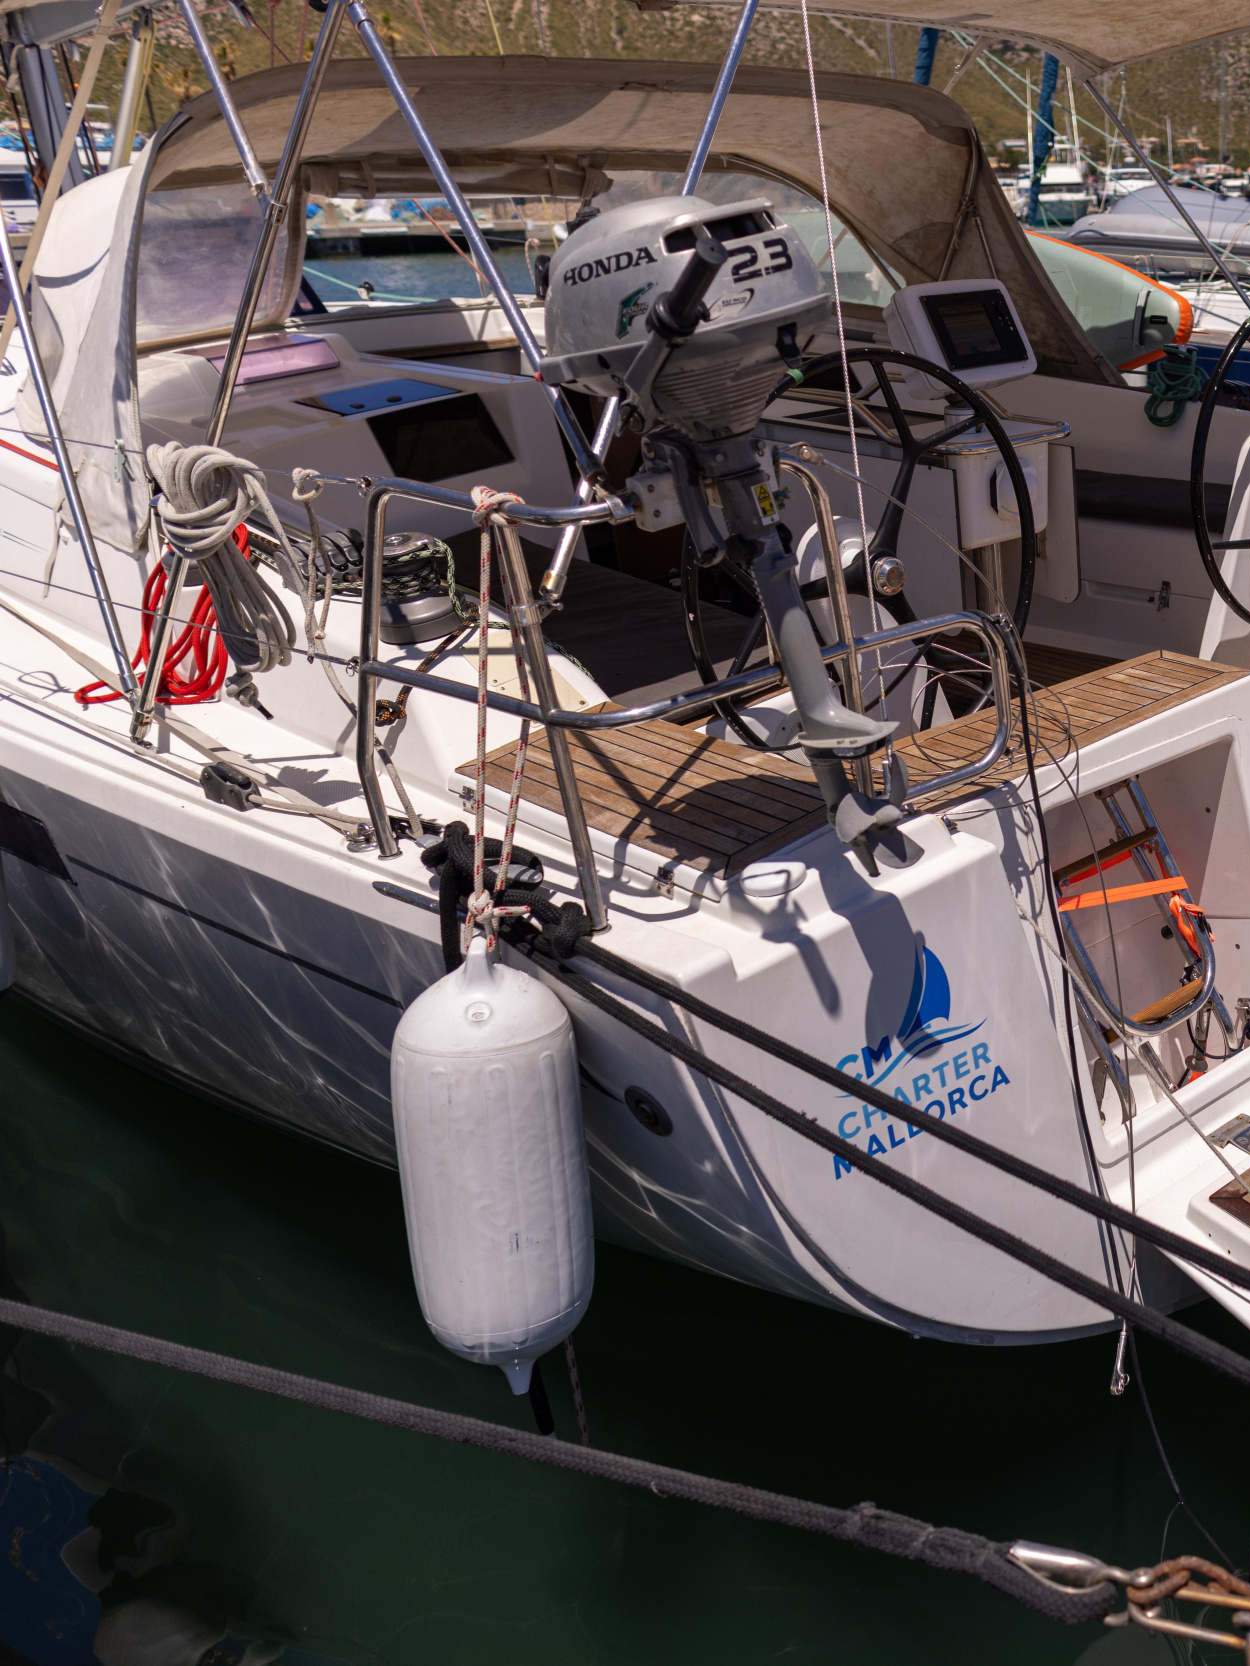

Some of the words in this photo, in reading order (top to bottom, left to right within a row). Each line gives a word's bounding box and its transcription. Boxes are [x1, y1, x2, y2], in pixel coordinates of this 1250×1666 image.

[563, 246, 657, 287] HONDA
[728, 237, 793, 284] 2.3
[838, 1042, 992, 1139] CHARTER
